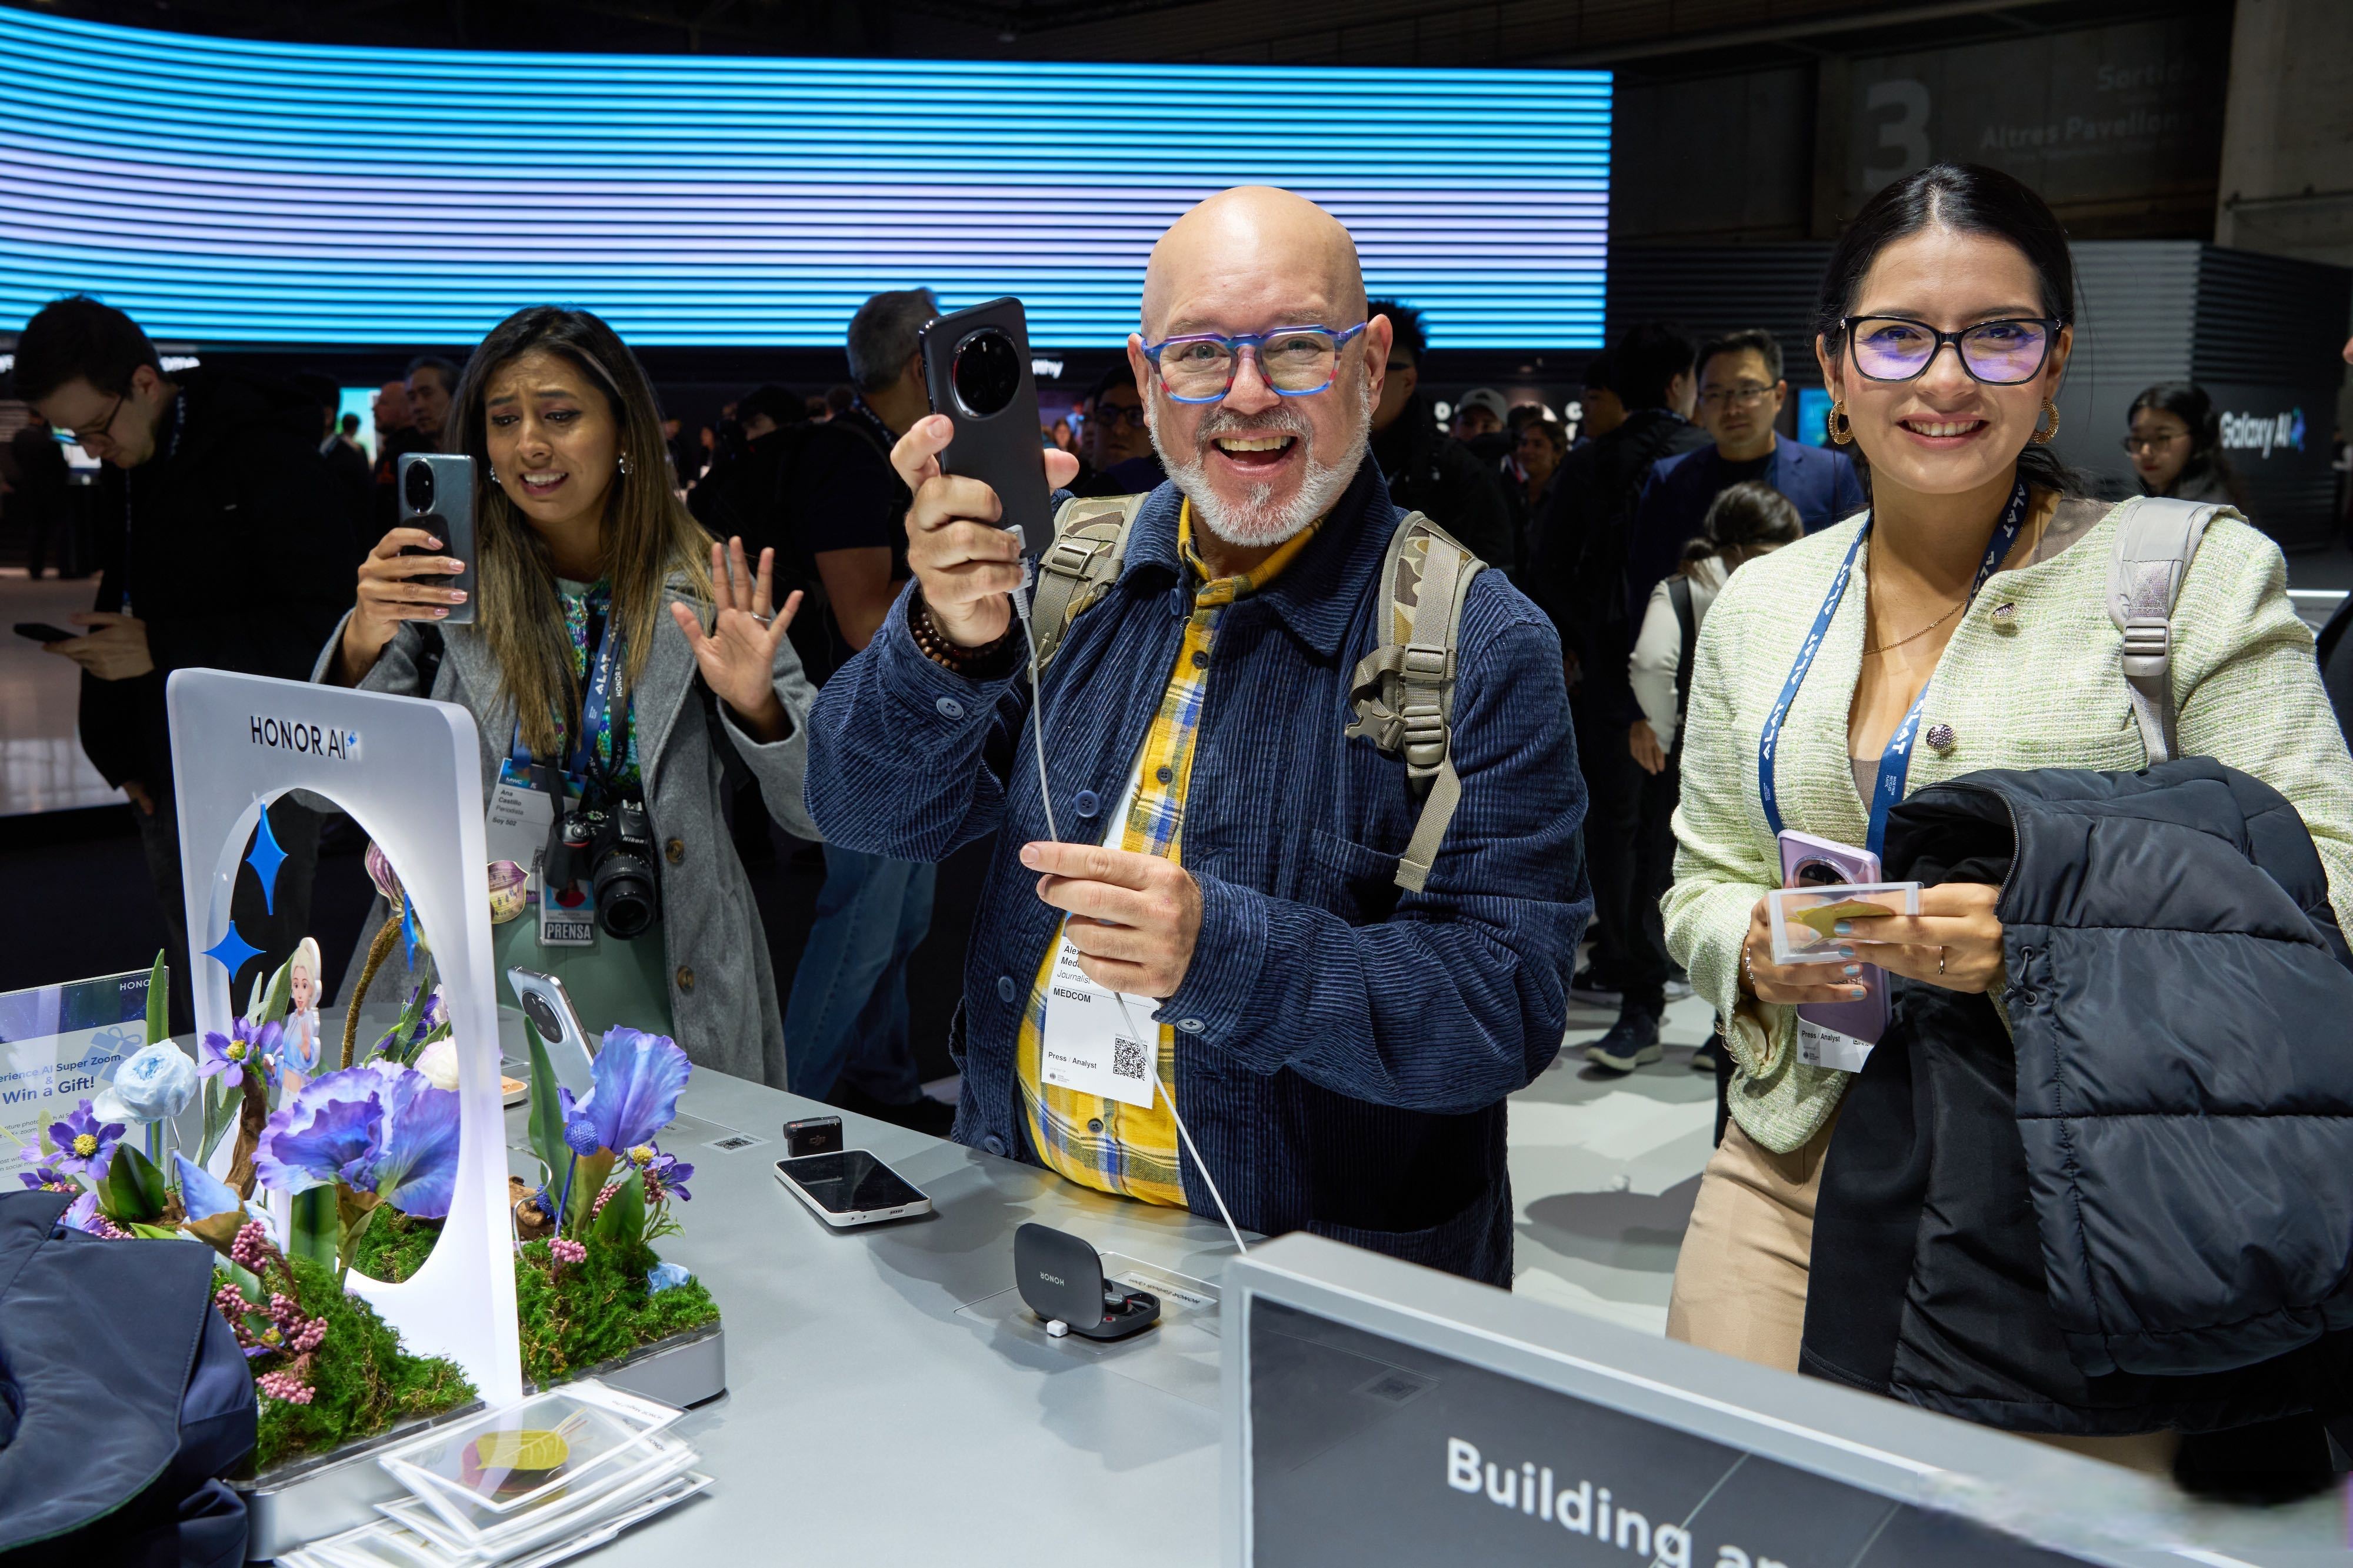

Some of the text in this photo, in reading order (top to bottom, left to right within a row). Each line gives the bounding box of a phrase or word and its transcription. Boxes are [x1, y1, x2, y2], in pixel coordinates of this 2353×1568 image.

[1864, 79, 1931, 194] 3
[2219, 411, 2292, 459] Galaxy AI
[2003, 483, 2025, 538] ALAT
[1972, 551, 1995, 595] ALA
[1824, 563, 1849, 616] ALAT
[1791, 633, 1819, 685] ALAT
[595, 653, 611, 695] ALAT
[251, 715, 346, 760] HONOR AI
[1763, 702, 1784, 760] ALAT
[1892, 699, 1925, 755] ALAT
[506, 777, 522, 785] MWC
[498, 797, 522, 806] Castillo
[622, 836, 644, 844] Nikon
[546, 923, 591, 939] PRENSA
[119, 979, 152, 991] HONO
[1057, 970, 1091, 984] Journalist
[1054, 987, 1091, 1003] MEDCOM
[1802, 1030, 1817, 1039] Press
[1821, 1033, 1840, 1043] Analyst
[42, 1065, 53, 1075] AI
[56, 1060, 88, 1072] Super
[90, 1054, 121, 1066] Zoom
[1048, 1052, 1067, 1062] Press
[1072, 1057, 1096, 1069] Analyst
[2, 1076, 94, 1105] Win a Gift!
[45, 1076, 54, 1085] &
[1040, 1272, 1064, 1286] HONOR
[1172, 1292, 1201, 1303] HONOR
[1448, 1437, 1691, 1568] Building
